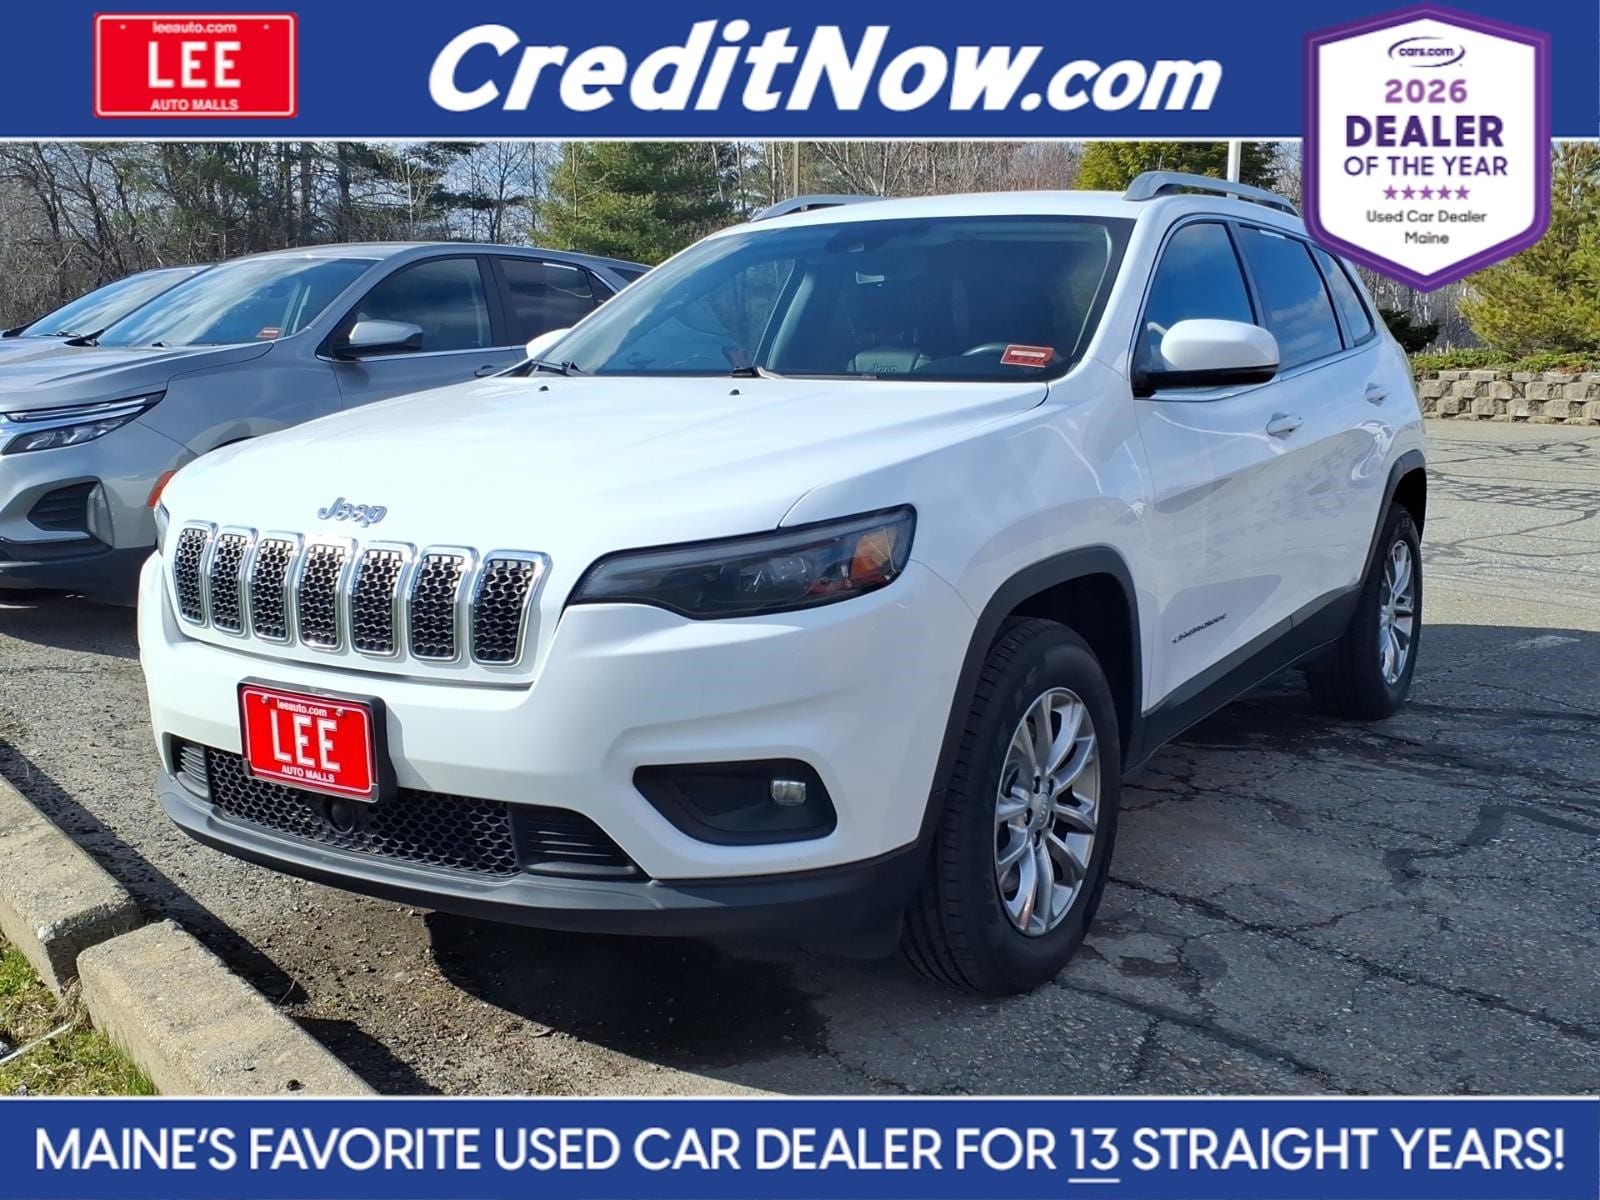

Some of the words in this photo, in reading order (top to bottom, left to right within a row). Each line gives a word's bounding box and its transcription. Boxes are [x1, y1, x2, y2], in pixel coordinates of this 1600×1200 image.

[317, 497, 388, 528] Jeep
[277, 700, 328, 718] leeauto.com
[270, 709, 341, 772] LEE
[281, 764, 304, 778] AUTO
[305, 770, 336, 783] MALLS
